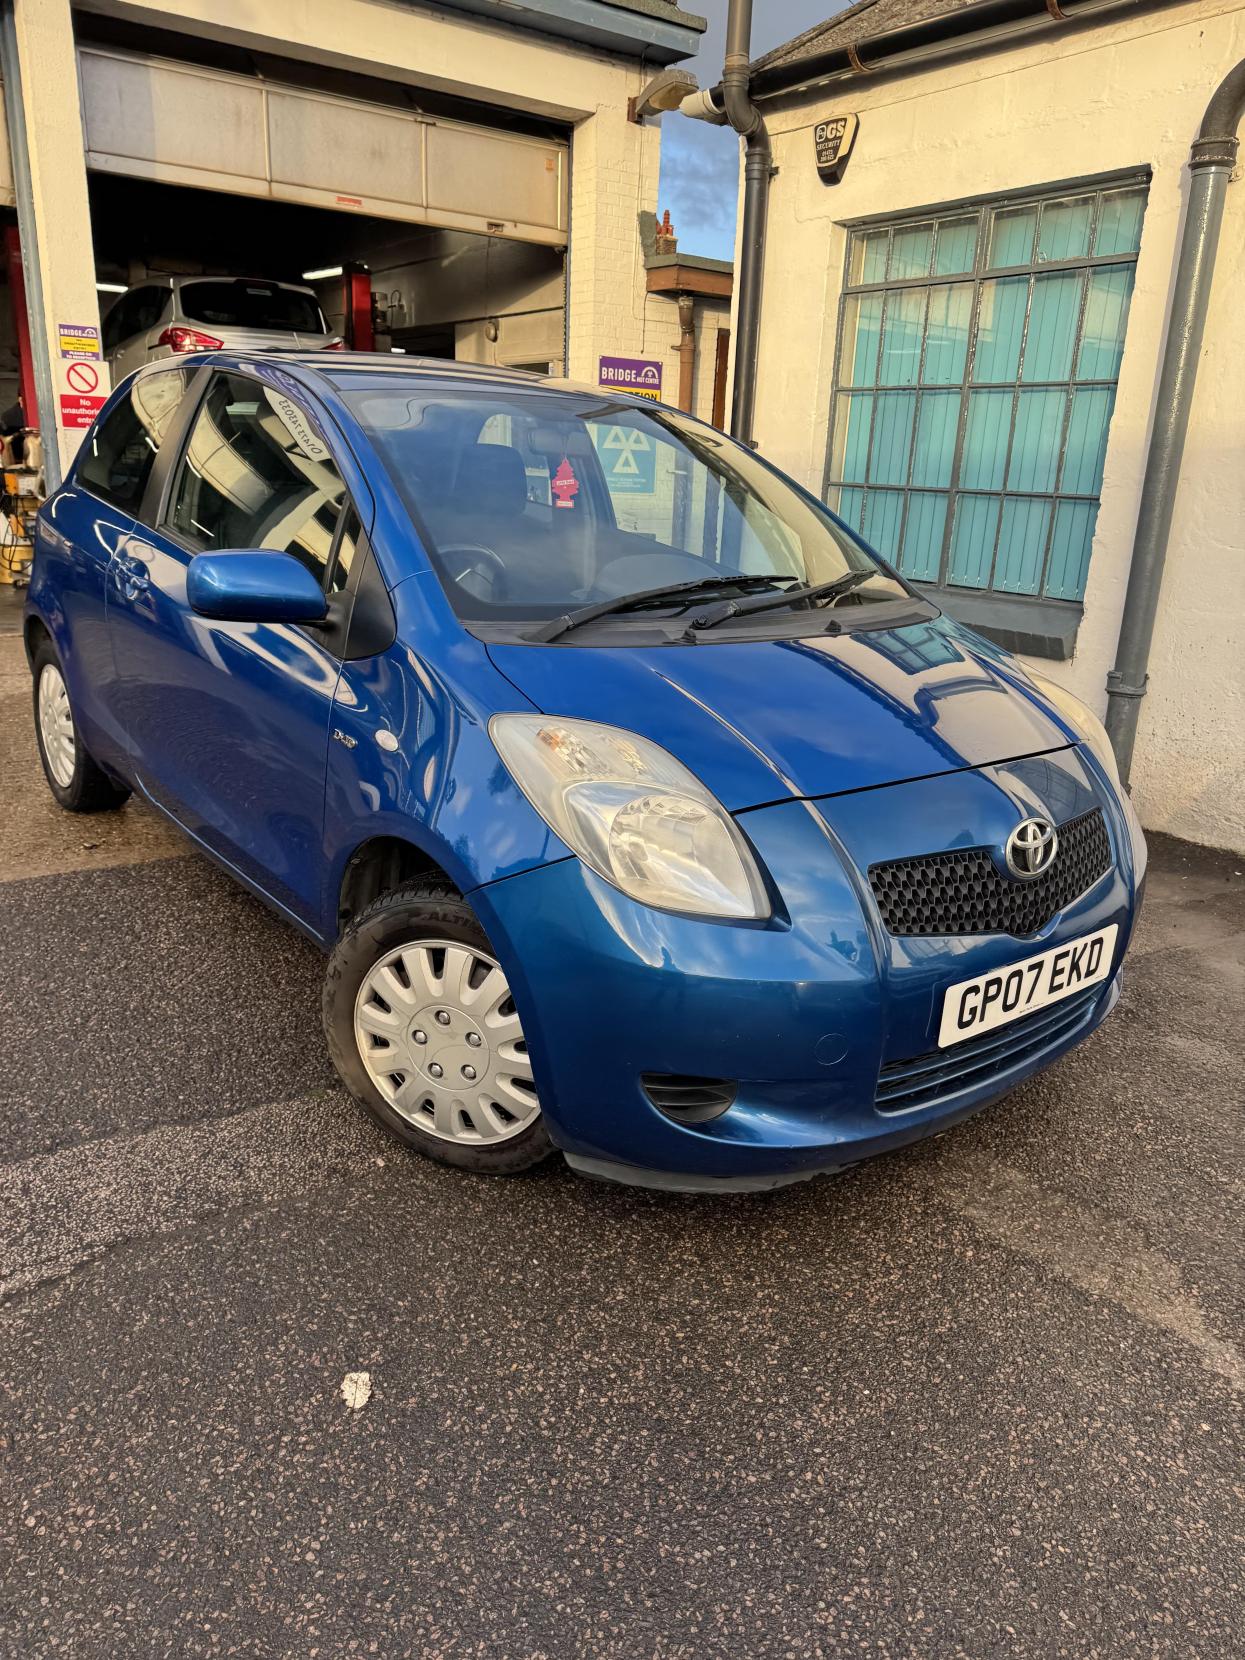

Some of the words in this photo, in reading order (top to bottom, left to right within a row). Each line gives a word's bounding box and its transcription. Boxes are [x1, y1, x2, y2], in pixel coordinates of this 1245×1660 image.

[816, 140, 841, 151] SECURITY
[601, 367, 637, 382] BRIDGE
[80, 398, 92, 406] No
[957, 960, 1044, 1030] GP07
[1048, 936, 1104, 995] EKD
